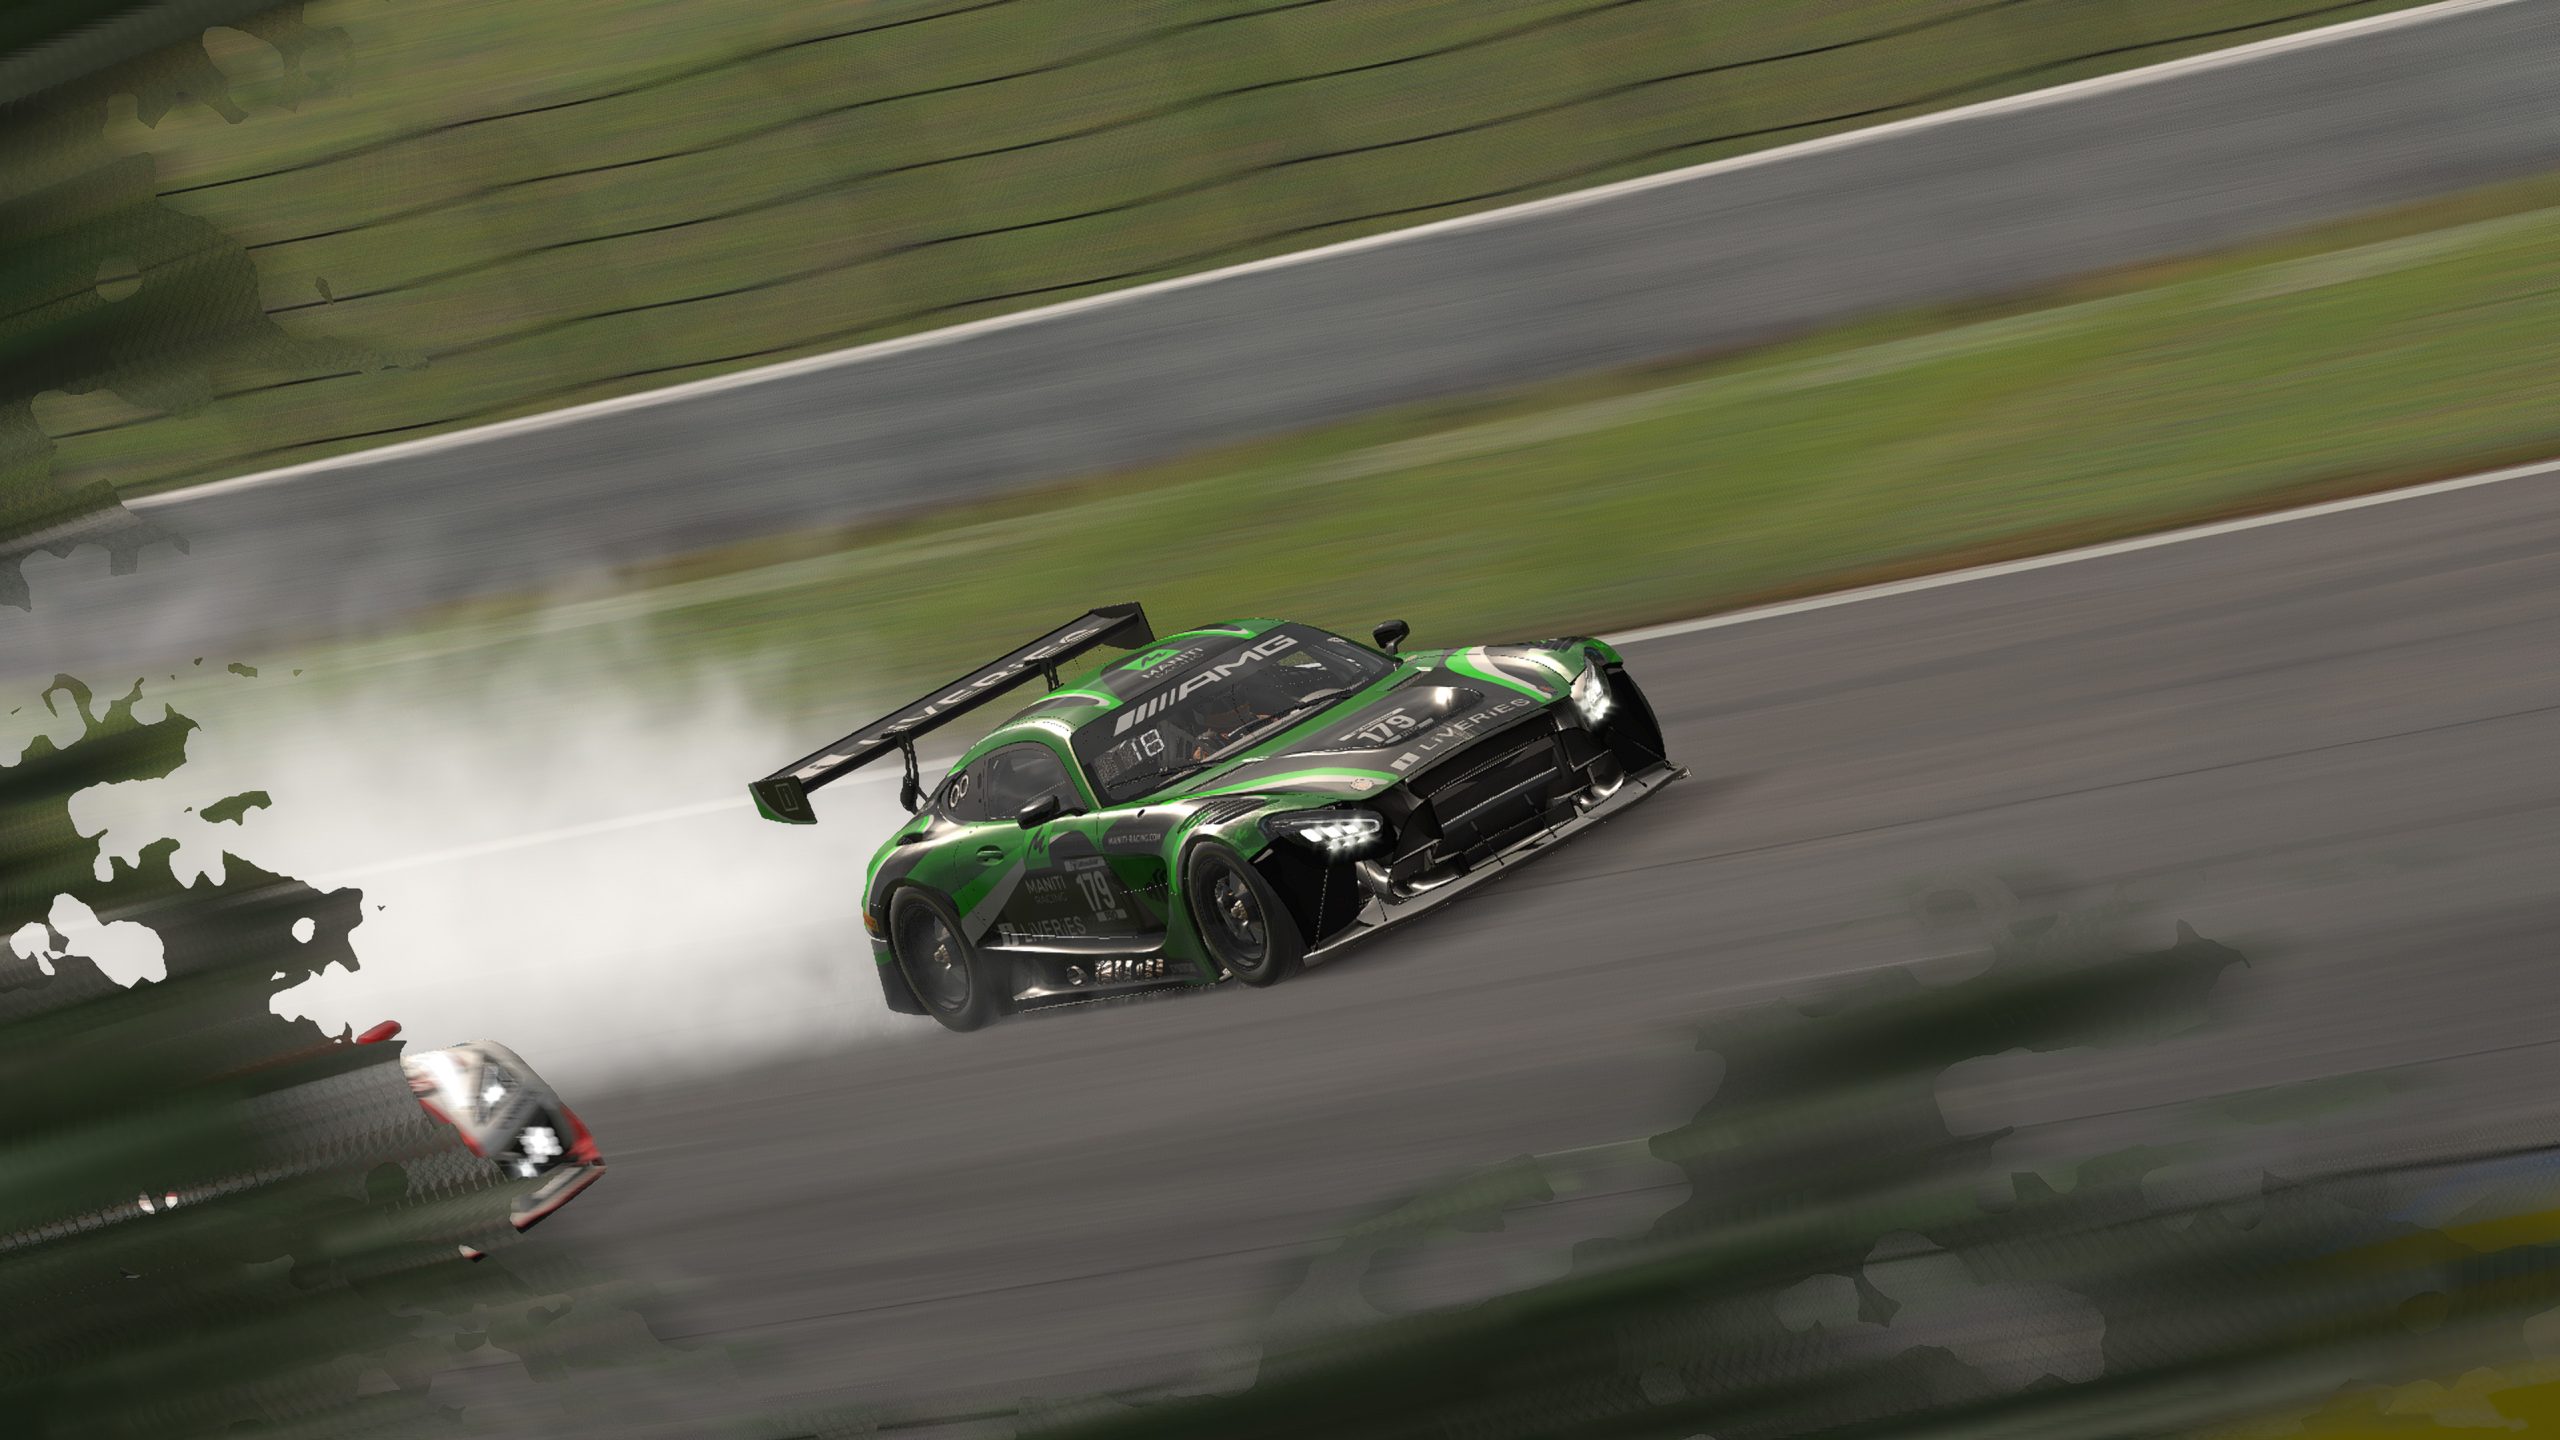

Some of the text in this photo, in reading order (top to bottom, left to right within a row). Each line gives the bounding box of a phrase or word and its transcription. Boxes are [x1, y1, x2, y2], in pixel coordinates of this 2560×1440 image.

[1178, 634, 1299, 701] AMG
[1356, 714, 1417, 744] 179
[1024, 874, 1067, 895] MANITI
[1076, 870, 1116, 912] 179
